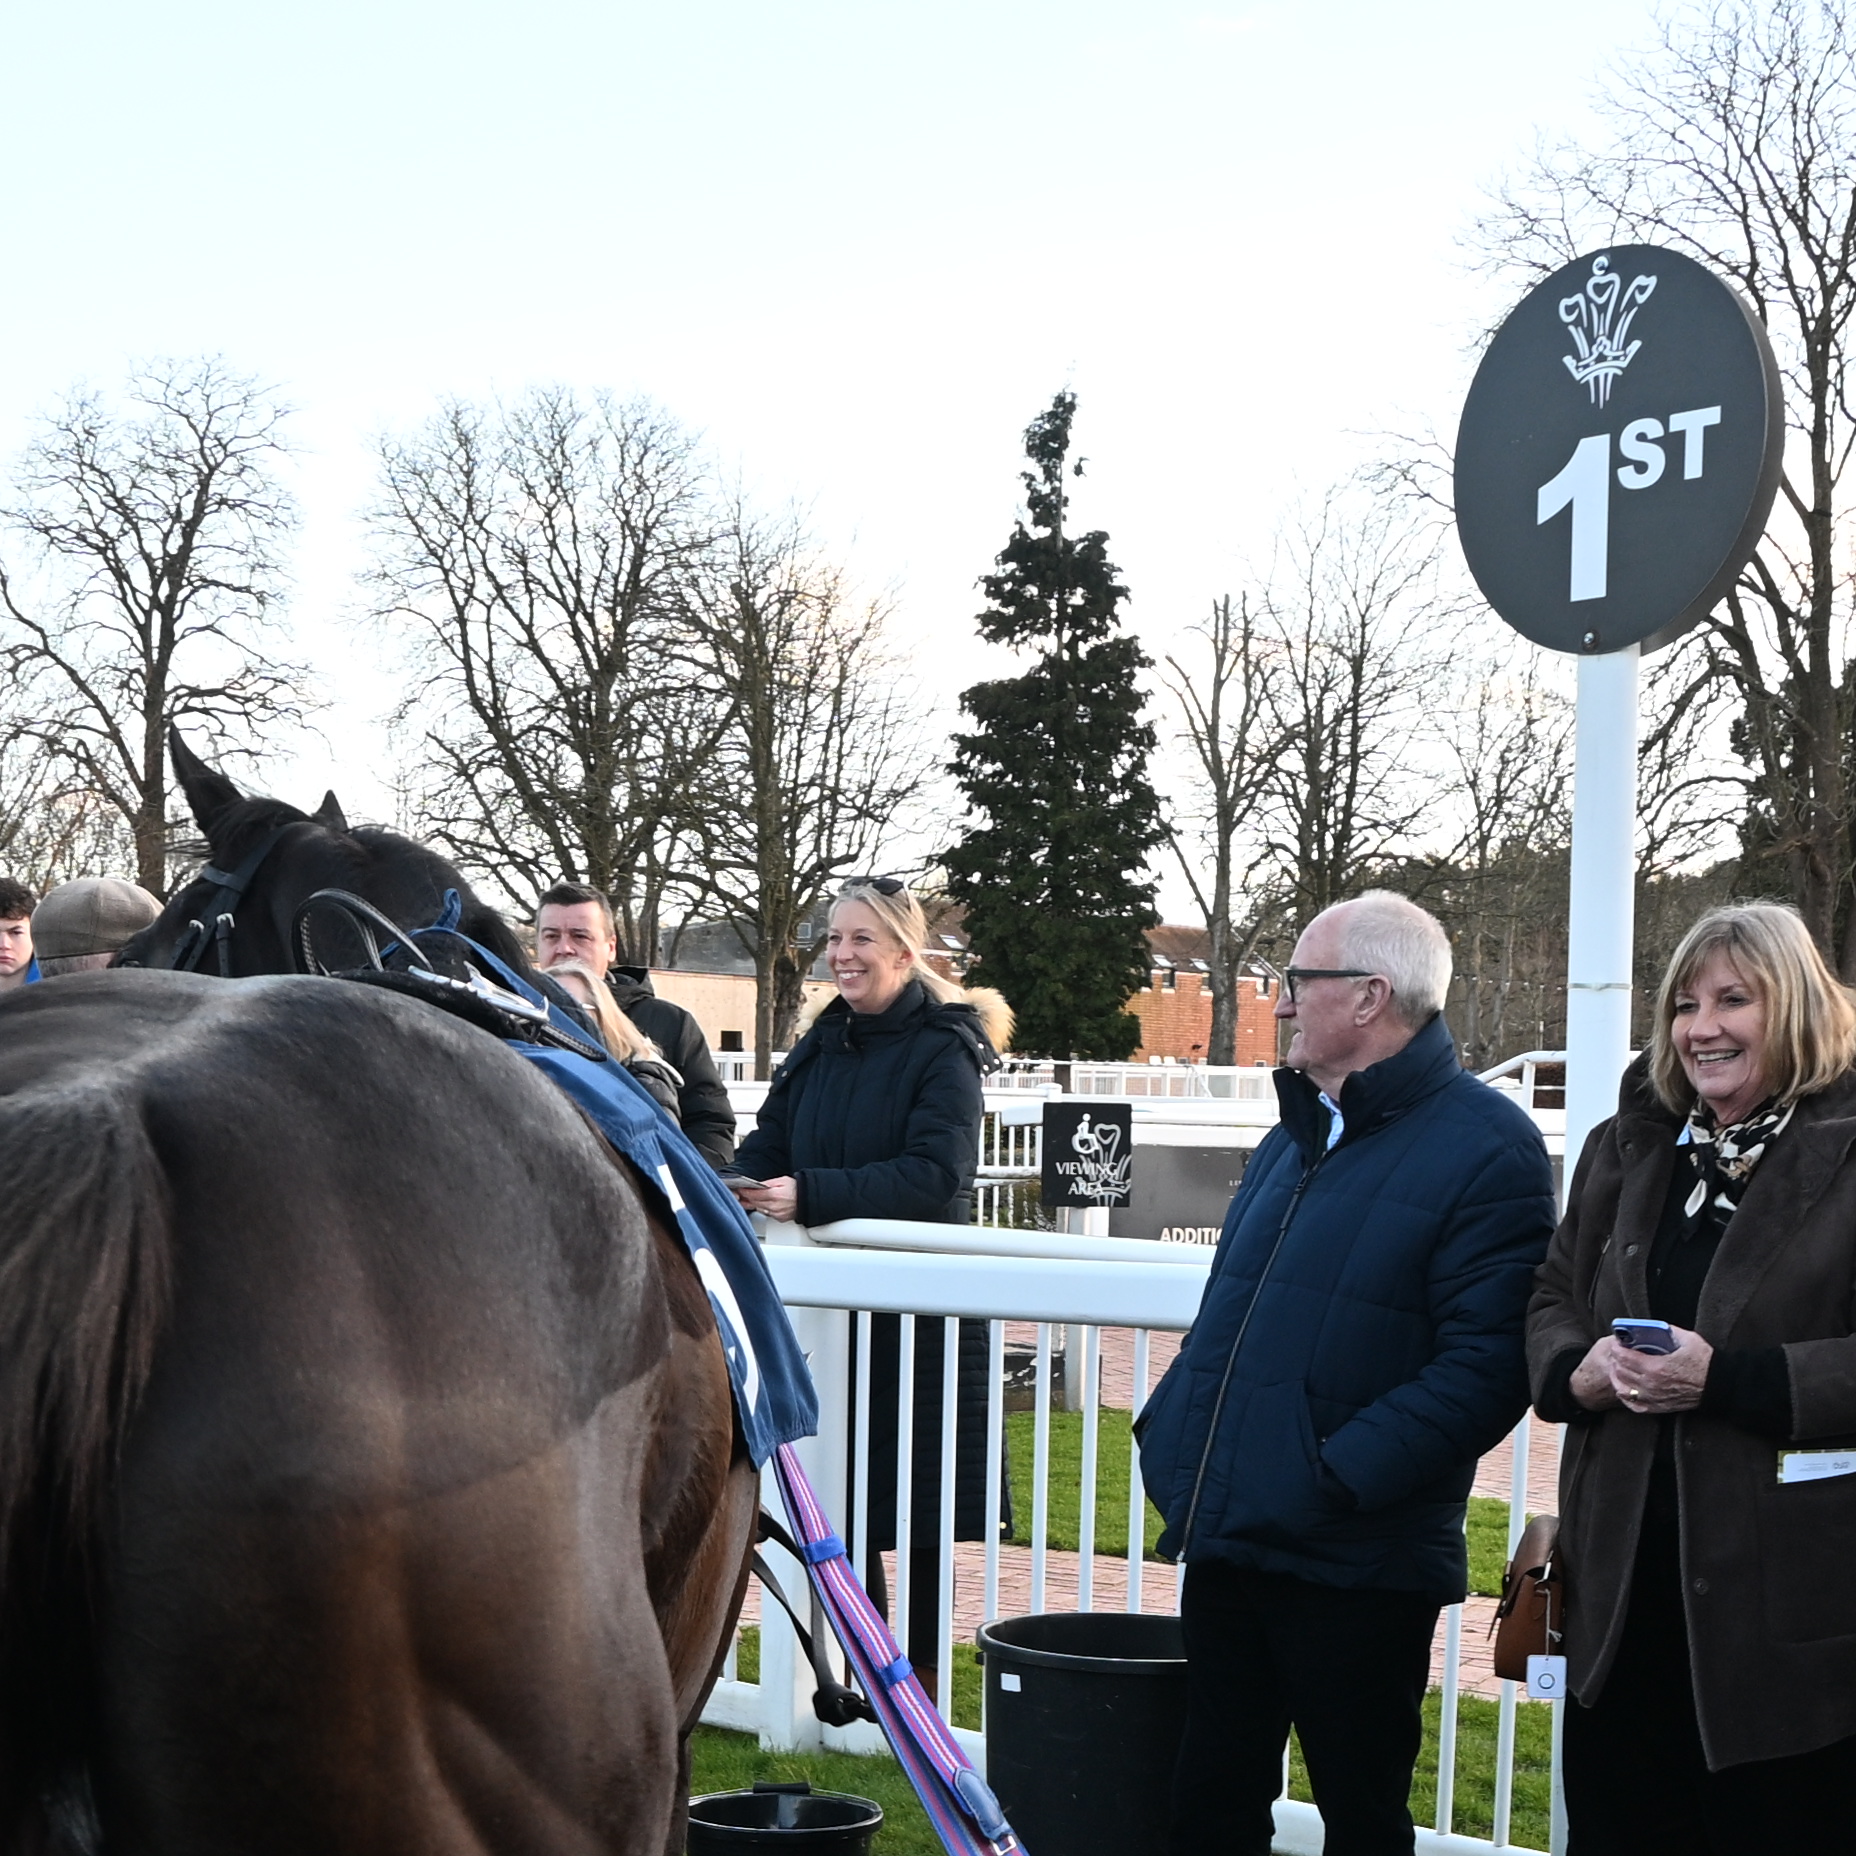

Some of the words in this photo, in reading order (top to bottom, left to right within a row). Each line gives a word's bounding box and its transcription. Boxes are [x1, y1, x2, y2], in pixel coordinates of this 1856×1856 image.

[1537, 405, 1722, 602] 1ST
[1055, 1161, 1118, 1176] VIEWING
[1068, 1182, 1105, 1196] AREA
[1160, 1227, 1222, 1244] ADDITI
